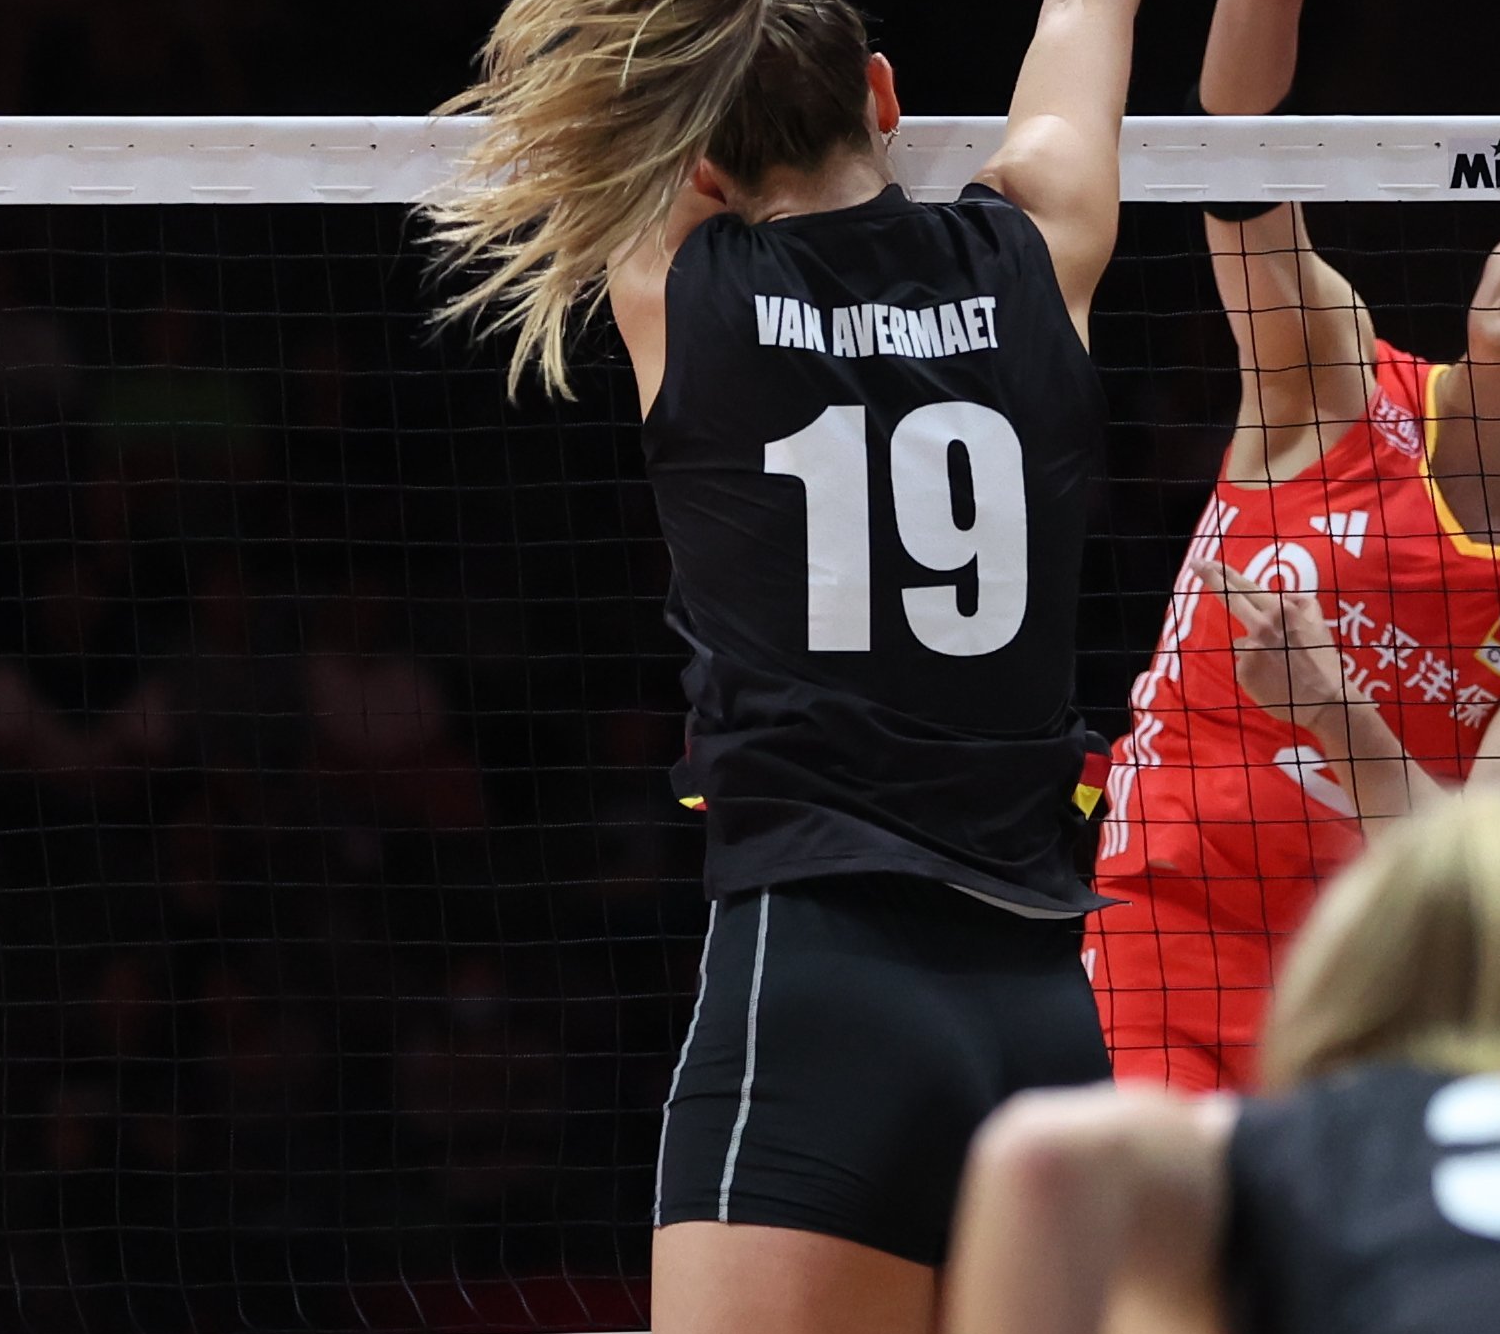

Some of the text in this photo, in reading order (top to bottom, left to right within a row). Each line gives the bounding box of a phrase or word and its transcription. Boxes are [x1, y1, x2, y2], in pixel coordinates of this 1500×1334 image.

[755, 295, 998, 358] VAN AVERMAET
[764, 401, 1028, 656] 19
